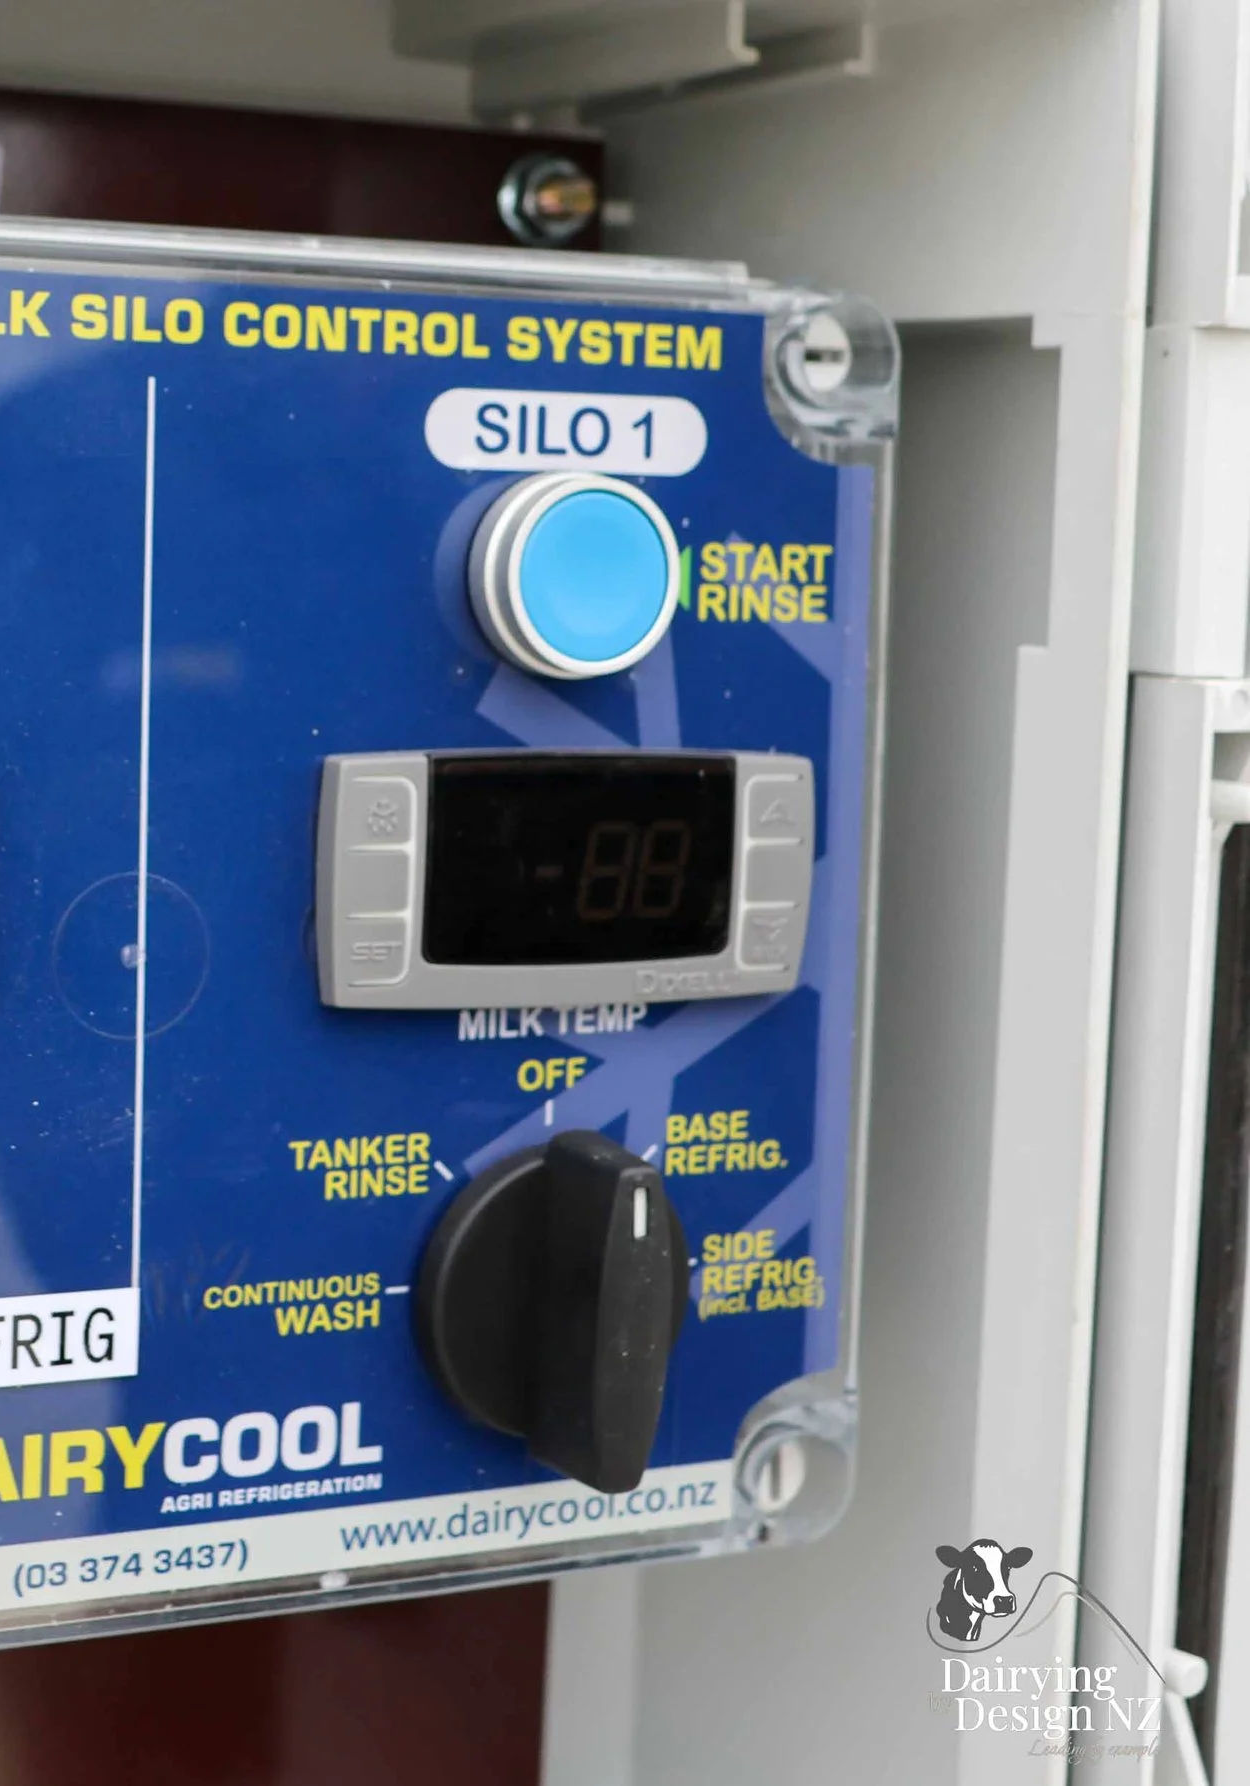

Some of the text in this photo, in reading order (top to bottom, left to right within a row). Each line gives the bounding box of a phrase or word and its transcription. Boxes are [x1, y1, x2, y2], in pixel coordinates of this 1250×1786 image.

[71, 293, 204, 345] SILO
[223, 302, 490, 359] CONTROL
[506, 317, 723, 370] SYSTEM
[475, 402, 654, 460] SILO 1
[700, 541, 834, 583] START
[697, 583, 829, 623] RINSE
[350, 940, 403, 963] SET
[458, 1002, 648, 1042] MILK TEMP
[517, 1056, 587, 1092] OFF
[665, 1110, 751, 1144] BASE
[288, 1132, 431, 1171] TANKER
[665, 1139, 789, 1176] REFRIG.
[324, 1164, 430, 1201] RINSE
[702, 1229, 776, 1263] SIDE
[203, 1272, 381, 1310] CONTINUOUS
[698, 1284, 826, 1322] (incl. BASE)
[275, 1299, 381, 1337] WASH
[160, 1473, 383, 1513] AGRI REFRIGERATION
[340, 1479, 718, 1551] www.dairycool.co.nz
[13, 1560, 68, 1597] (03
[79, 1552, 141, 1584] 374
[152, 1538, 248, 1575] 3437)
